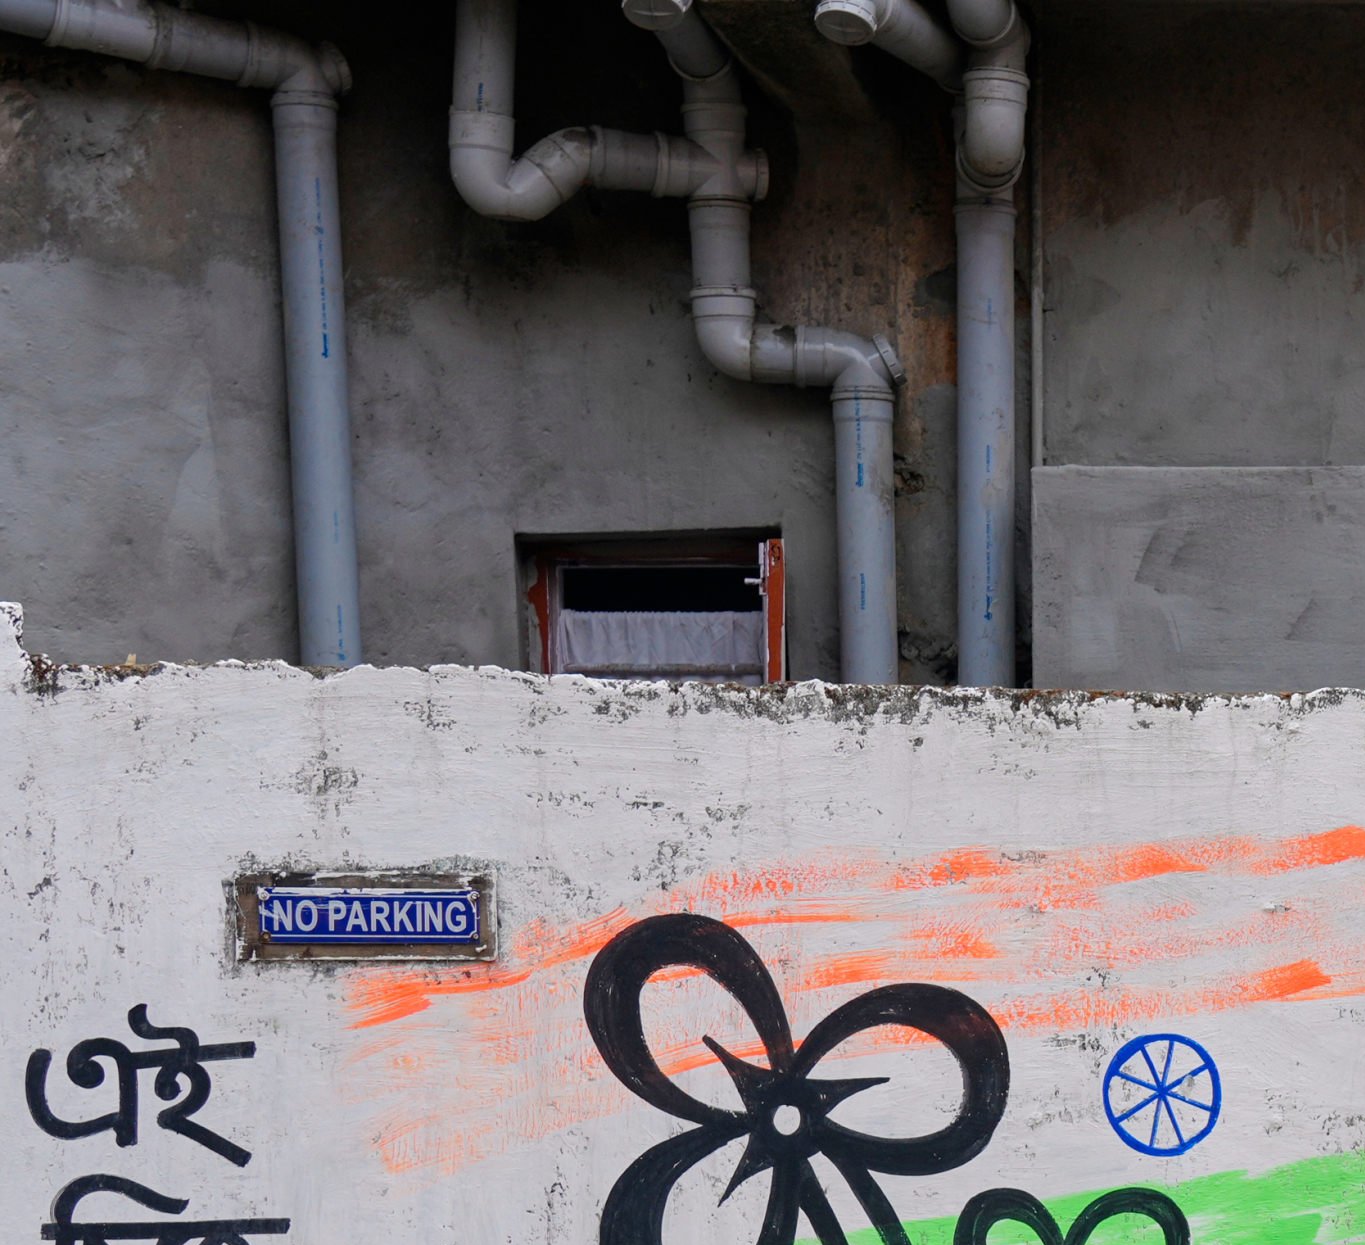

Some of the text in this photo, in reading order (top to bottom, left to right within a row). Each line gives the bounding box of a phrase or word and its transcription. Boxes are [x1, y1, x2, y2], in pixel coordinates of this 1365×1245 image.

[273, 899, 468, 933] NO PARKING
[25, 1003, 256, 1167] এই
